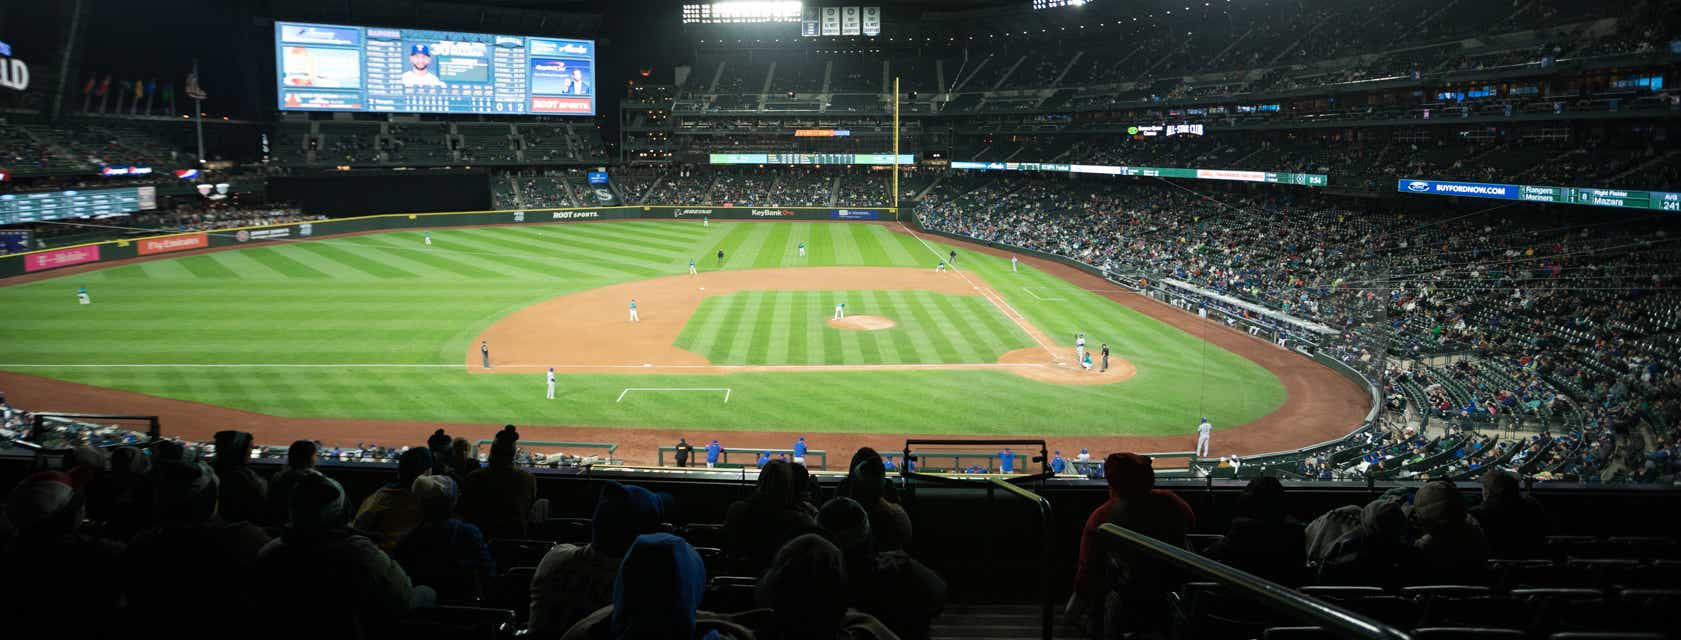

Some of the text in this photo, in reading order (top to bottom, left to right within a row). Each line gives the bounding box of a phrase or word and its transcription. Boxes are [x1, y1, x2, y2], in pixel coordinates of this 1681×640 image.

[0, 58, 29, 90] LD
[496, 102, 503, 111] 0
[508, 103, 513, 111] 1
[518, 103, 524, 111] 2
[1189, 124, 1203, 136] CLUB
[1436, 184, 1505, 195] BUYFORDNOW.COM
[1526, 186, 1553, 195] Rangers
[1594, 198, 1623, 206] Mazara
